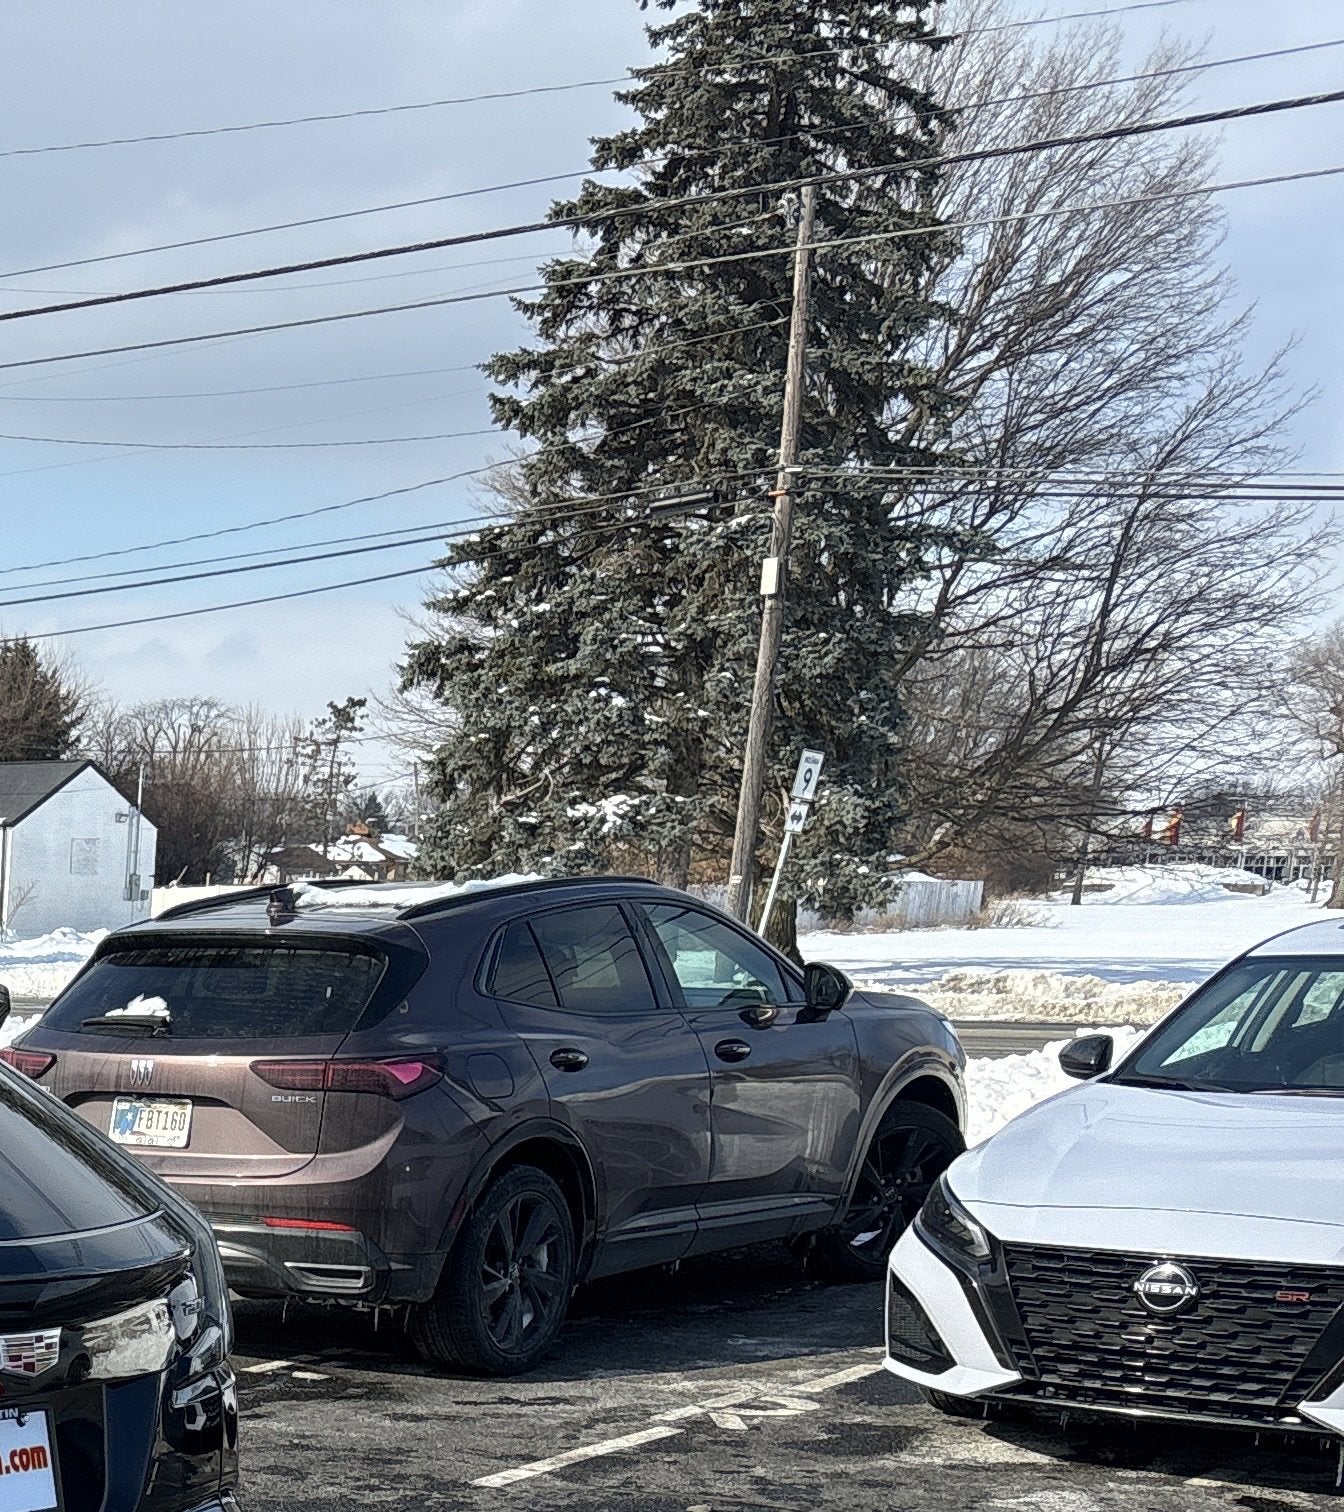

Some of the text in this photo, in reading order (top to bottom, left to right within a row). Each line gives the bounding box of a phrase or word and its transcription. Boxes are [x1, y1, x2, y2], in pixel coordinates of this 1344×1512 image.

[802, 767, 813, 795] 9
[271, 1095, 317, 1103] BUICK
[137, 1109, 187, 1131] FBT160
[1132, 1281, 1198, 1296] NISSAN
[1275, 1291, 1310, 1302] SR
